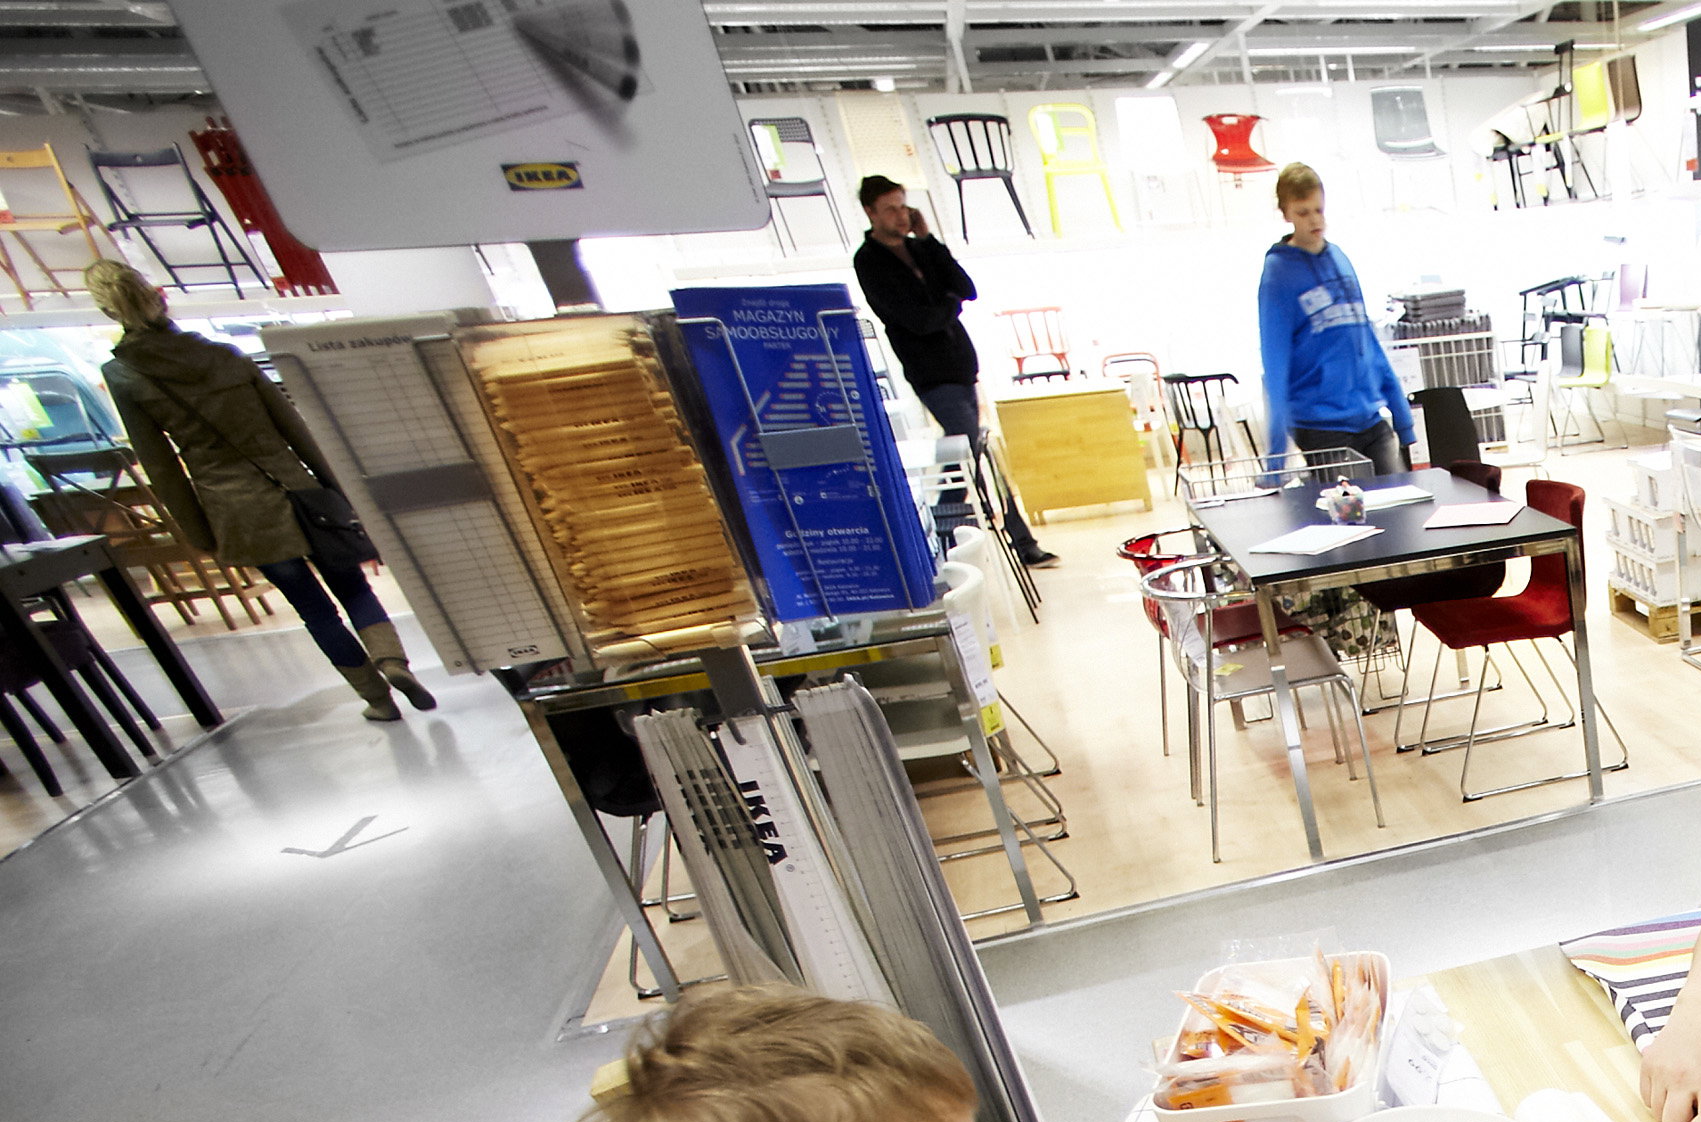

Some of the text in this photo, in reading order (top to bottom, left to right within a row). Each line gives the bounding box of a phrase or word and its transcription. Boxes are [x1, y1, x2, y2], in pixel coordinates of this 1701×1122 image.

[514, 169, 573, 183] IKEA
[733, 309, 806, 323] MAGAZYN
[307, 340, 346, 352] Lista
[738, 780, 788, 866] IKEA
